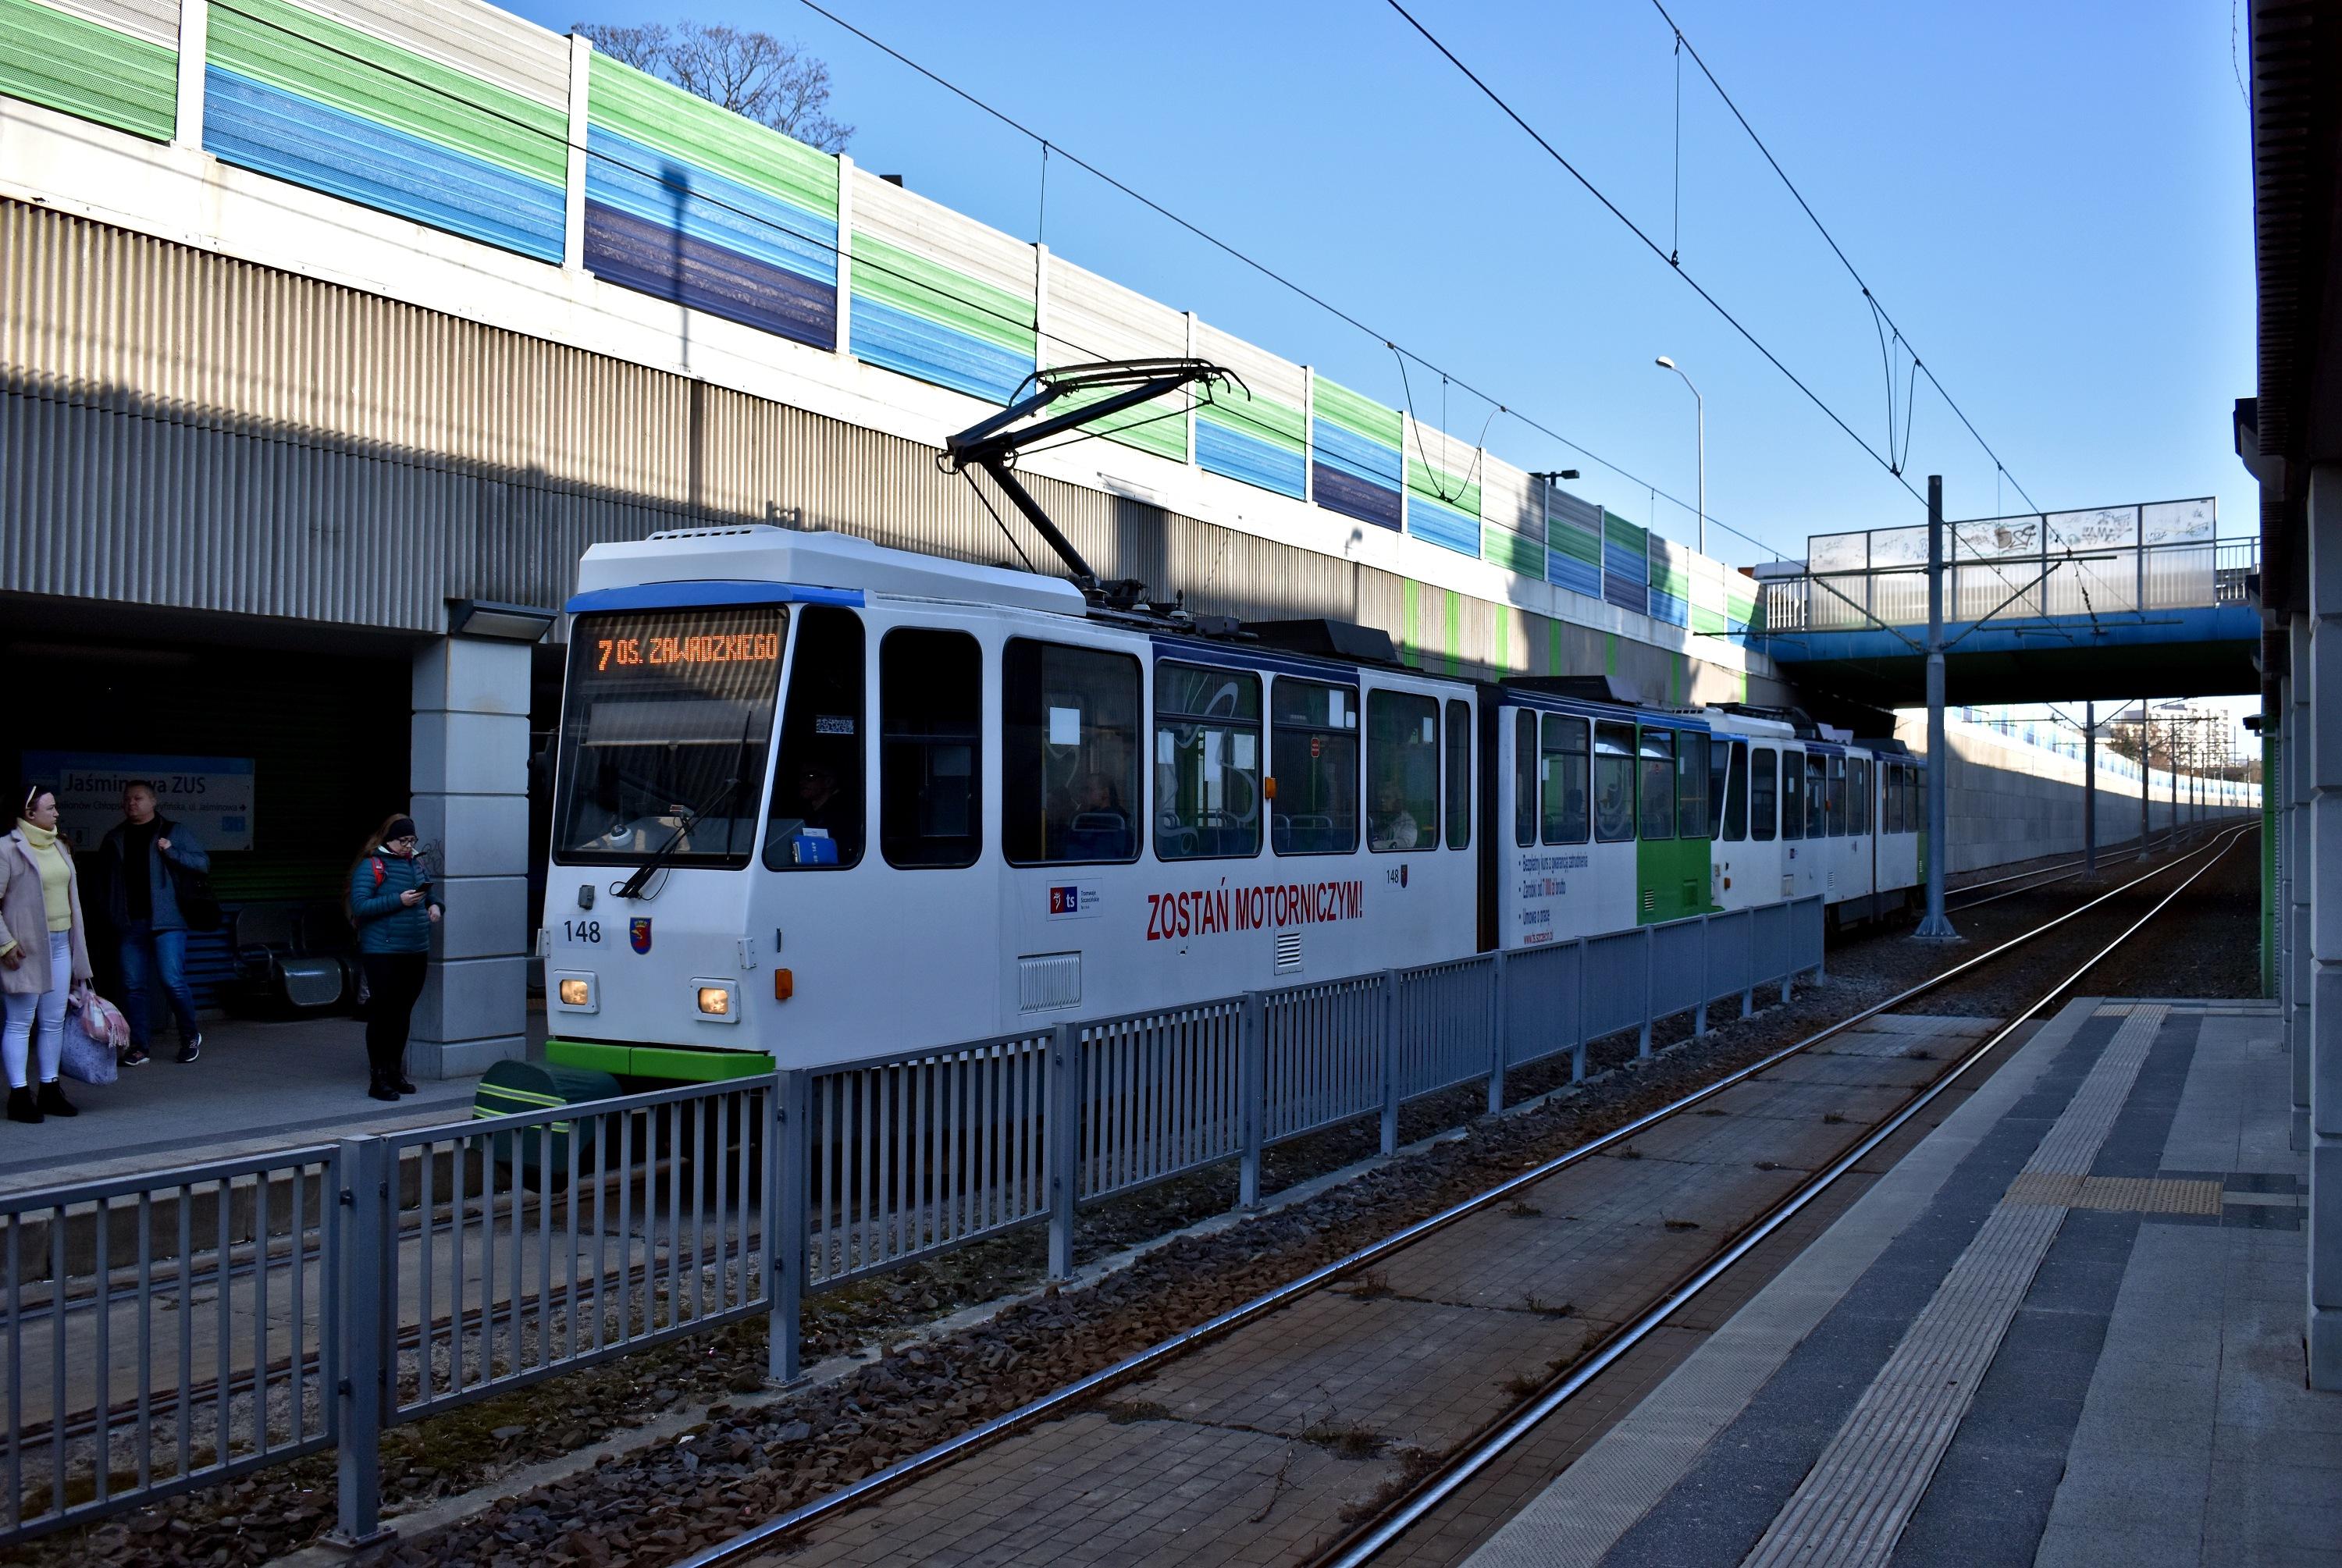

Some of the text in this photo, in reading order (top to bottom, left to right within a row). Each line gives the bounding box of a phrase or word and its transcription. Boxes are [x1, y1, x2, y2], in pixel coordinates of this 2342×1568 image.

[598, 633, 778, 671] 7 OS. ZAWADZKIEGO
[172, 776, 206, 794] ZUS
[1386, 869, 1399, 885] 148
[1066, 894, 1075, 908] ts
[1147, 876, 1363, 941] ZOSTAŃ MOTORNICZYM!
[563, 919, 602, 944] 148
